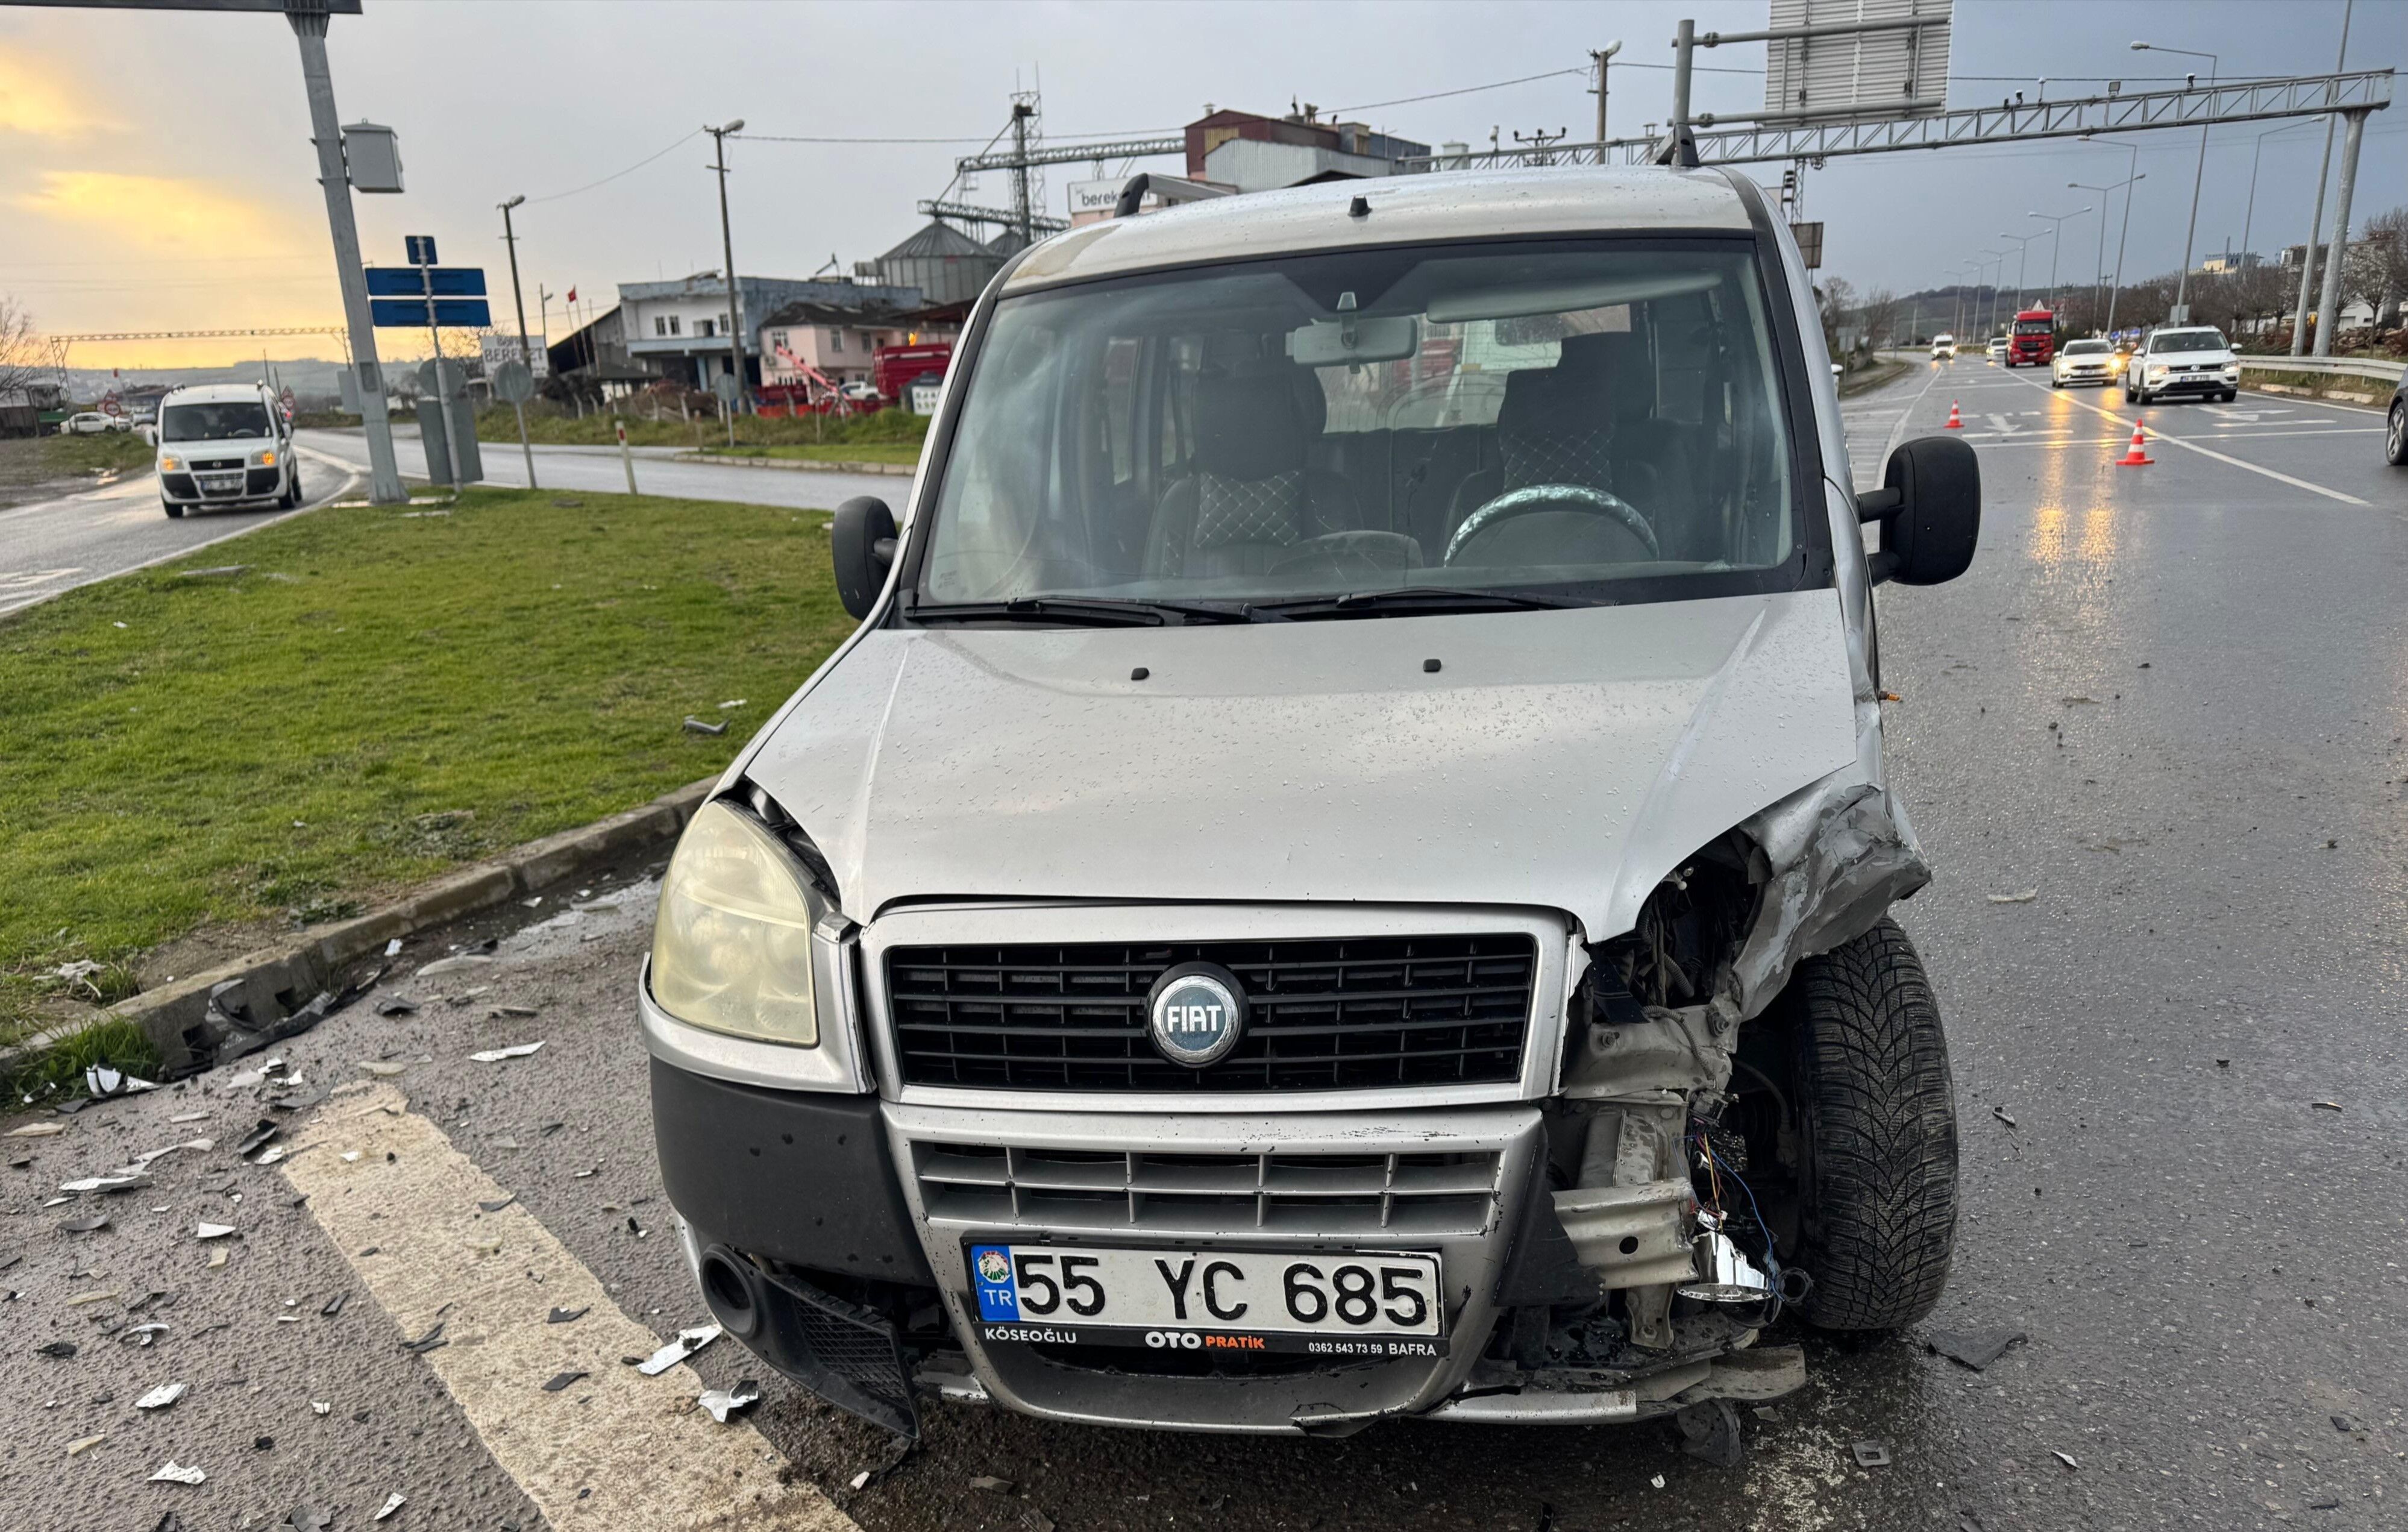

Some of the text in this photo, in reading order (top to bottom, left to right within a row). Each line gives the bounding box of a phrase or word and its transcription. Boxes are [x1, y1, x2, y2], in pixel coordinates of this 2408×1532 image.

[1167, 1005, 1221, 1032] FIAT
[984, 1289, 1013, 1307] TR
[1014, 1254, 1428, 1326] 55 YC 685
[984, 1326, 1077, 1344] KÖSEOĞLU
[1145, 1331, 1202, 1349] OTO
[1308, 1342, 1334, 1352] 0362
[1335, 1343, 1354, 1354] 543
[1356, 1343, 1369, 1354] 73
[1370, 1344, 1384, 1354] 59
[1388, 1343, 1437, 1356] BAFRA
